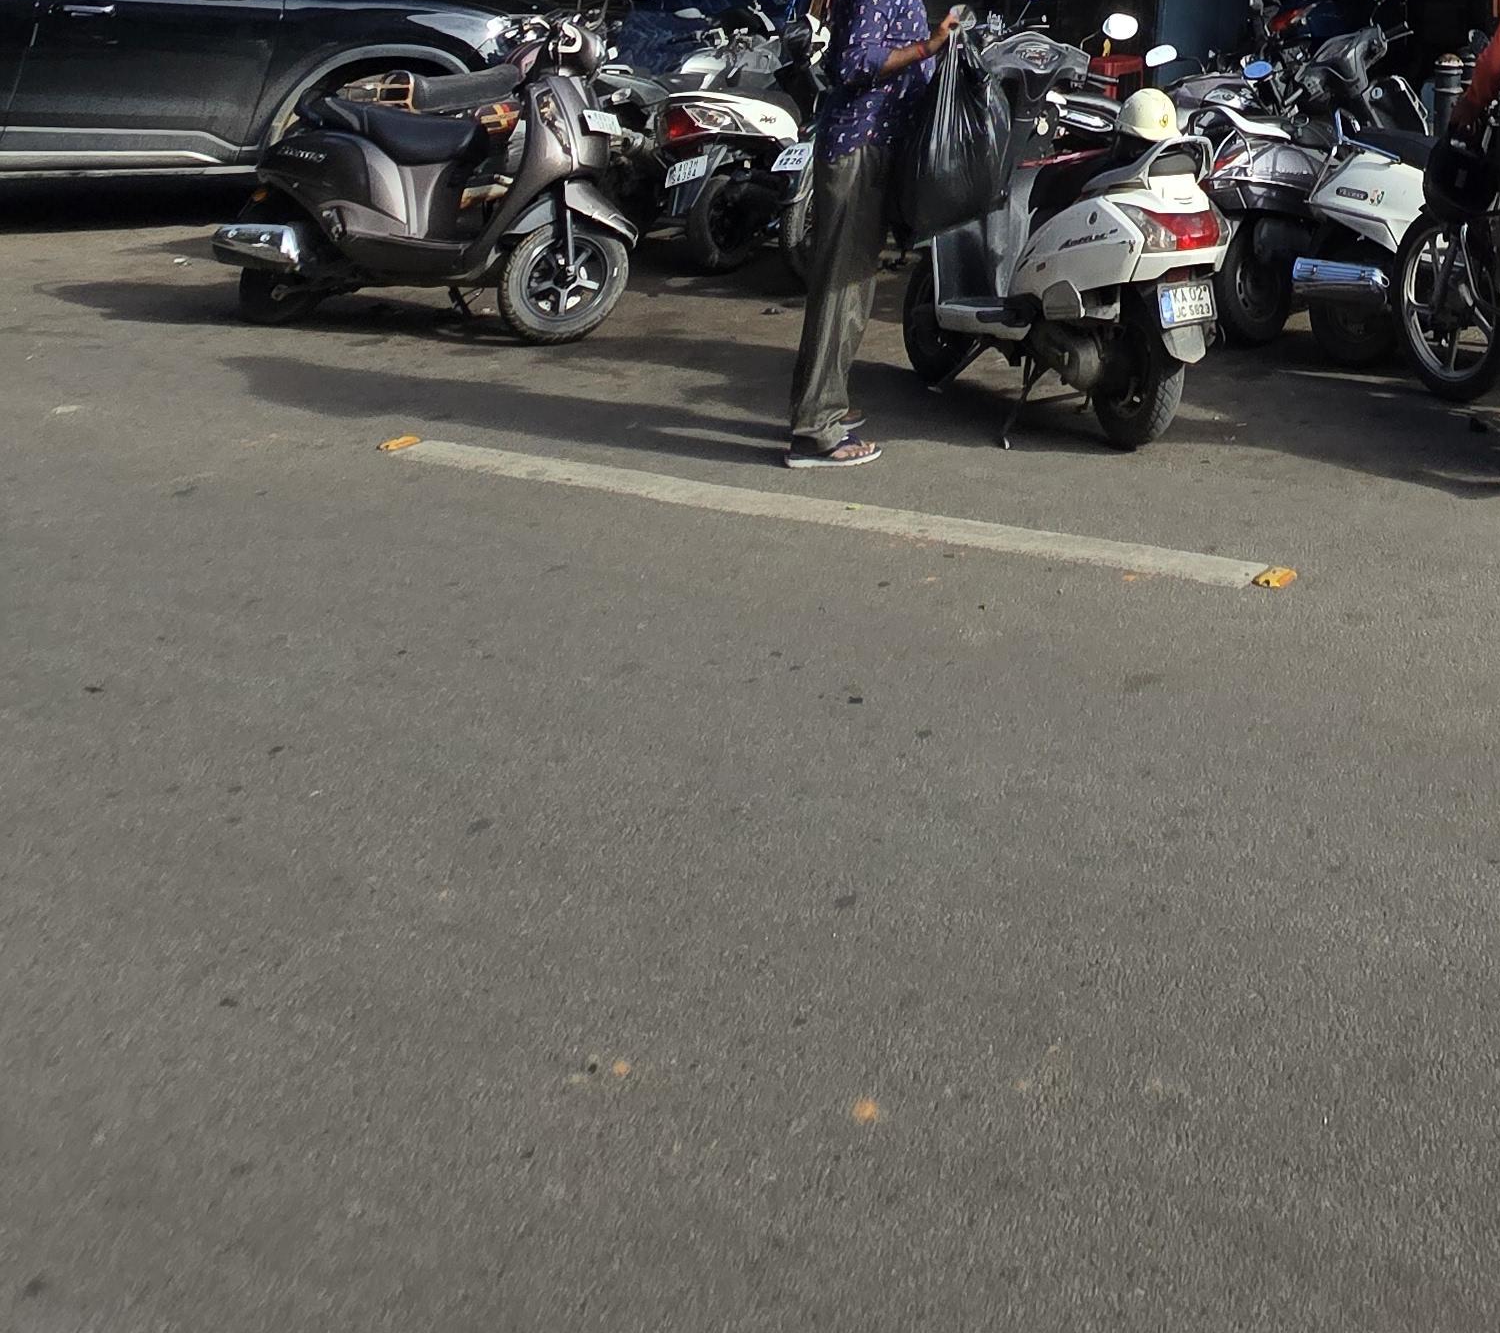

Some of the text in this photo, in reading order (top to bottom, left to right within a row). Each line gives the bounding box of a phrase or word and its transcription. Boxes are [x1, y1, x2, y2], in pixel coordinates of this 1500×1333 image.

[1173, 285, 1204, 303] KA 02
[1175, 305, 1187, 317] JC
